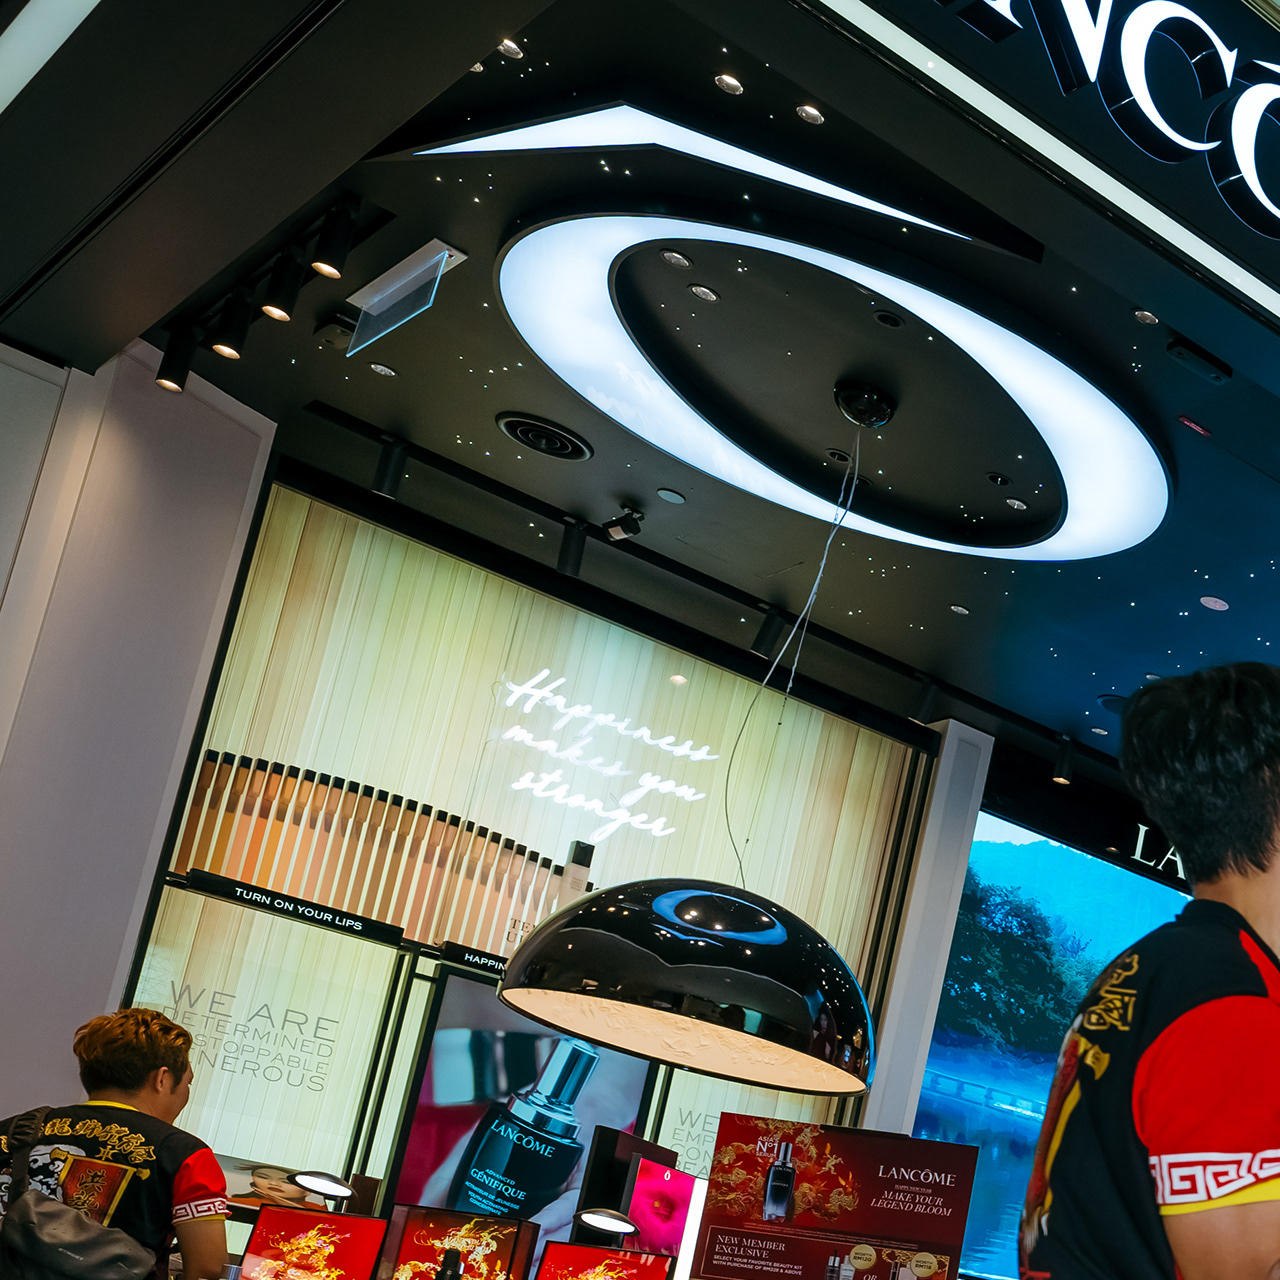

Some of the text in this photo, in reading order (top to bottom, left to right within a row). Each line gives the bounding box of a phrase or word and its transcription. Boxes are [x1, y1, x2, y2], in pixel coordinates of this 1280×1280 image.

[235, 887, 363, 931] TURN ON YOUR LIPS
[171, 980, 340, 1043] WE ARE
[162, 1006, 333, 1058] DETERMINED
[193, 1033, 330, 1076] STOPPABLE
[191, 1047, 325, 1092] NEROUS
[679, 1107, 721, 1135] WE
[490, 1119, 556, 1158] LANCÔME
[470, 1168, 527, 1201] GÉNIFIQUE
[485, 1168, 516, 1186] ADVANCED
[878, 1165, 957, 1187] LANCÔME
[870, 1198, 953, 1217] LEGEND BLOOM
[881, 1190, 944, 1206] MAKE YOUR
[715, 1244, 770, 1259] EXCLUSIVE
[716, 1234, 741, 1245] NEW
[742, 1237, 786, 1251] MEMBER
[726, 1261, 754, 1270] PURCHASE
[773, 1261, 794, 1269] BEAUTY
